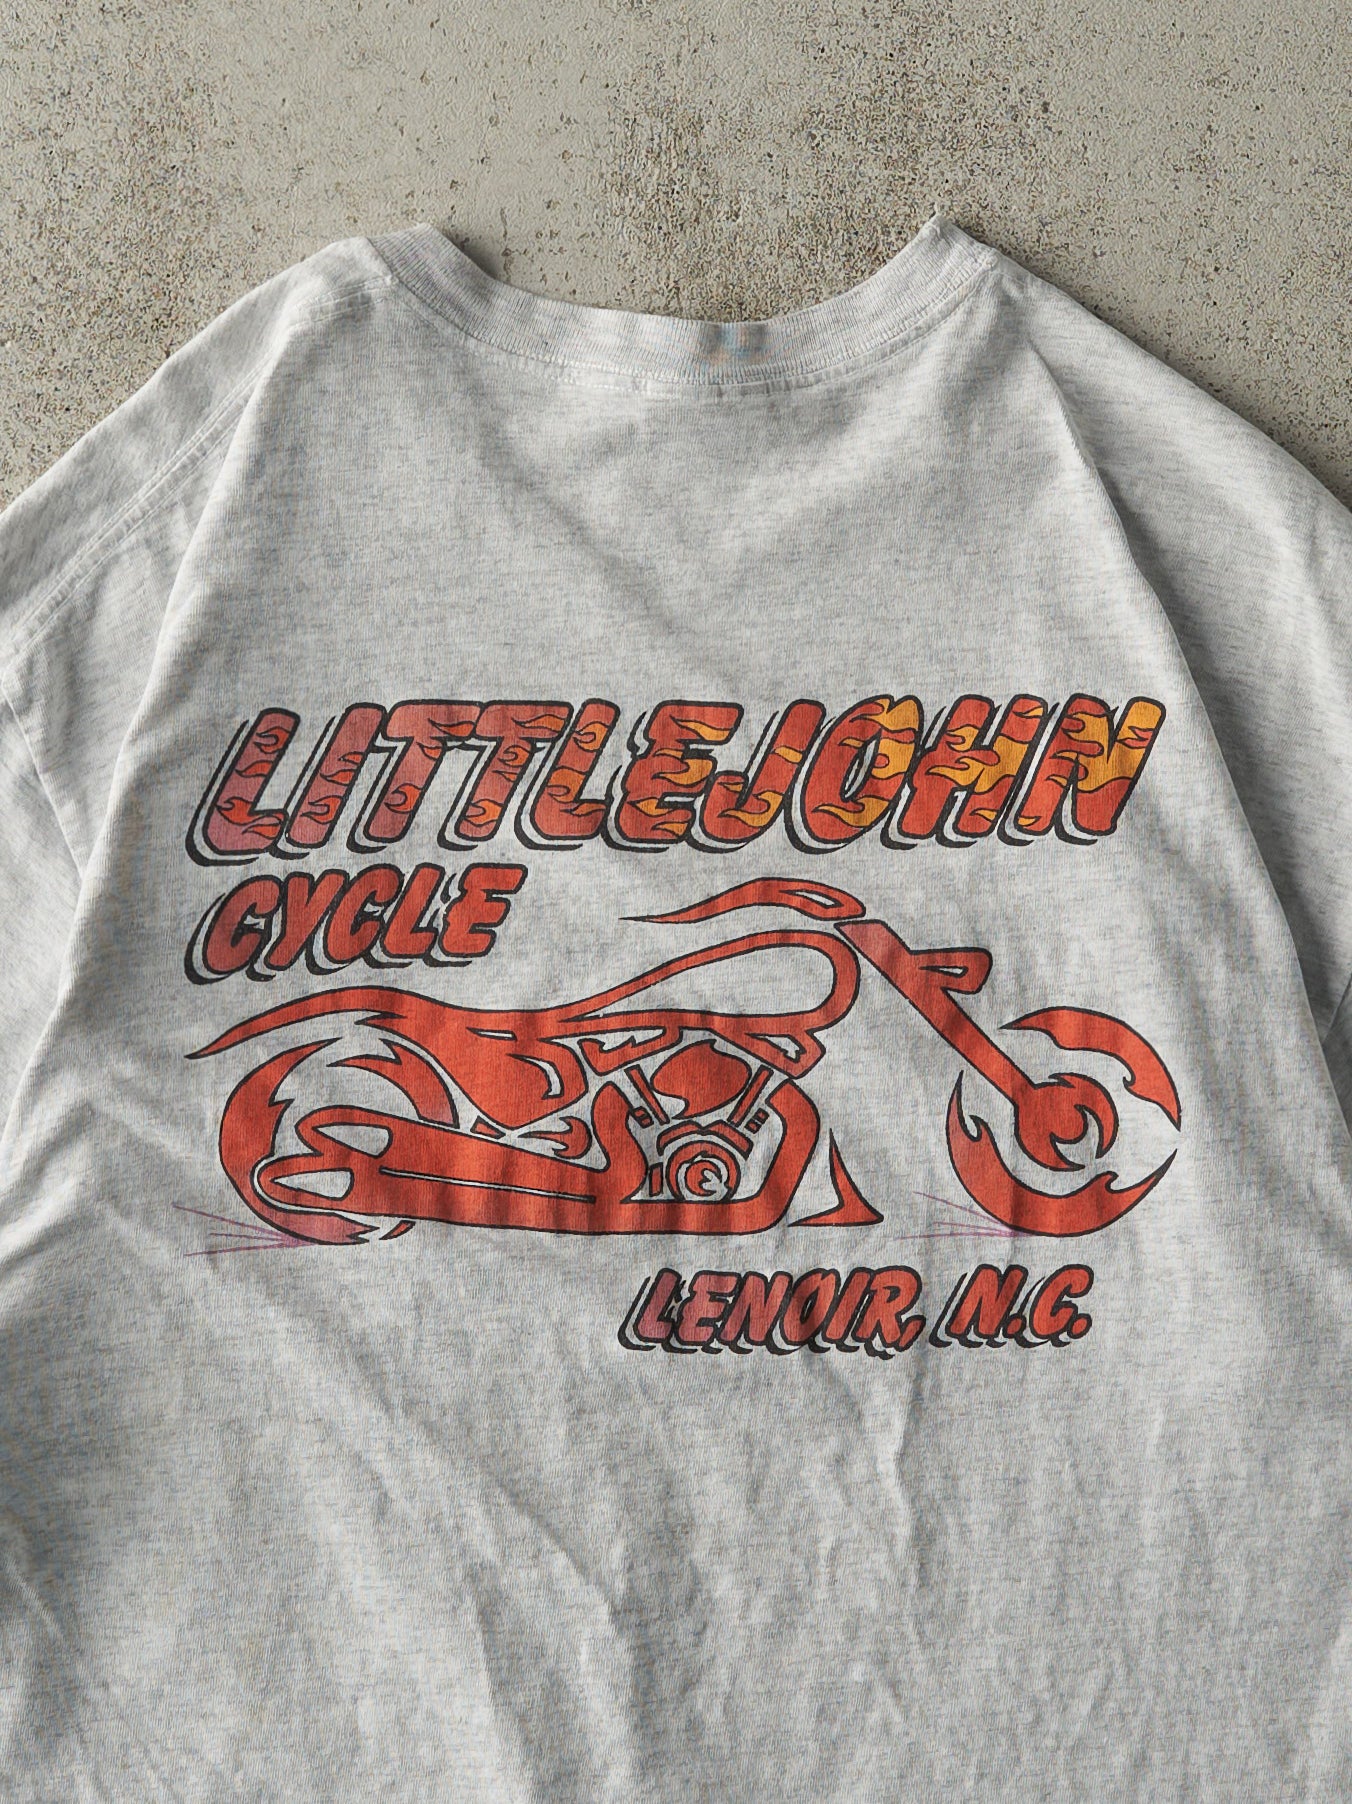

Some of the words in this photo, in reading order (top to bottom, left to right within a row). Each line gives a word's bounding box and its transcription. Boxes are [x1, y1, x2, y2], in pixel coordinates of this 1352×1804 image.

[185, 694, 1166, 866] LITTLEJOHN
[184, 862, 528, 985] CYCLE
[929, 1263, 1094, 1348] N.C.
